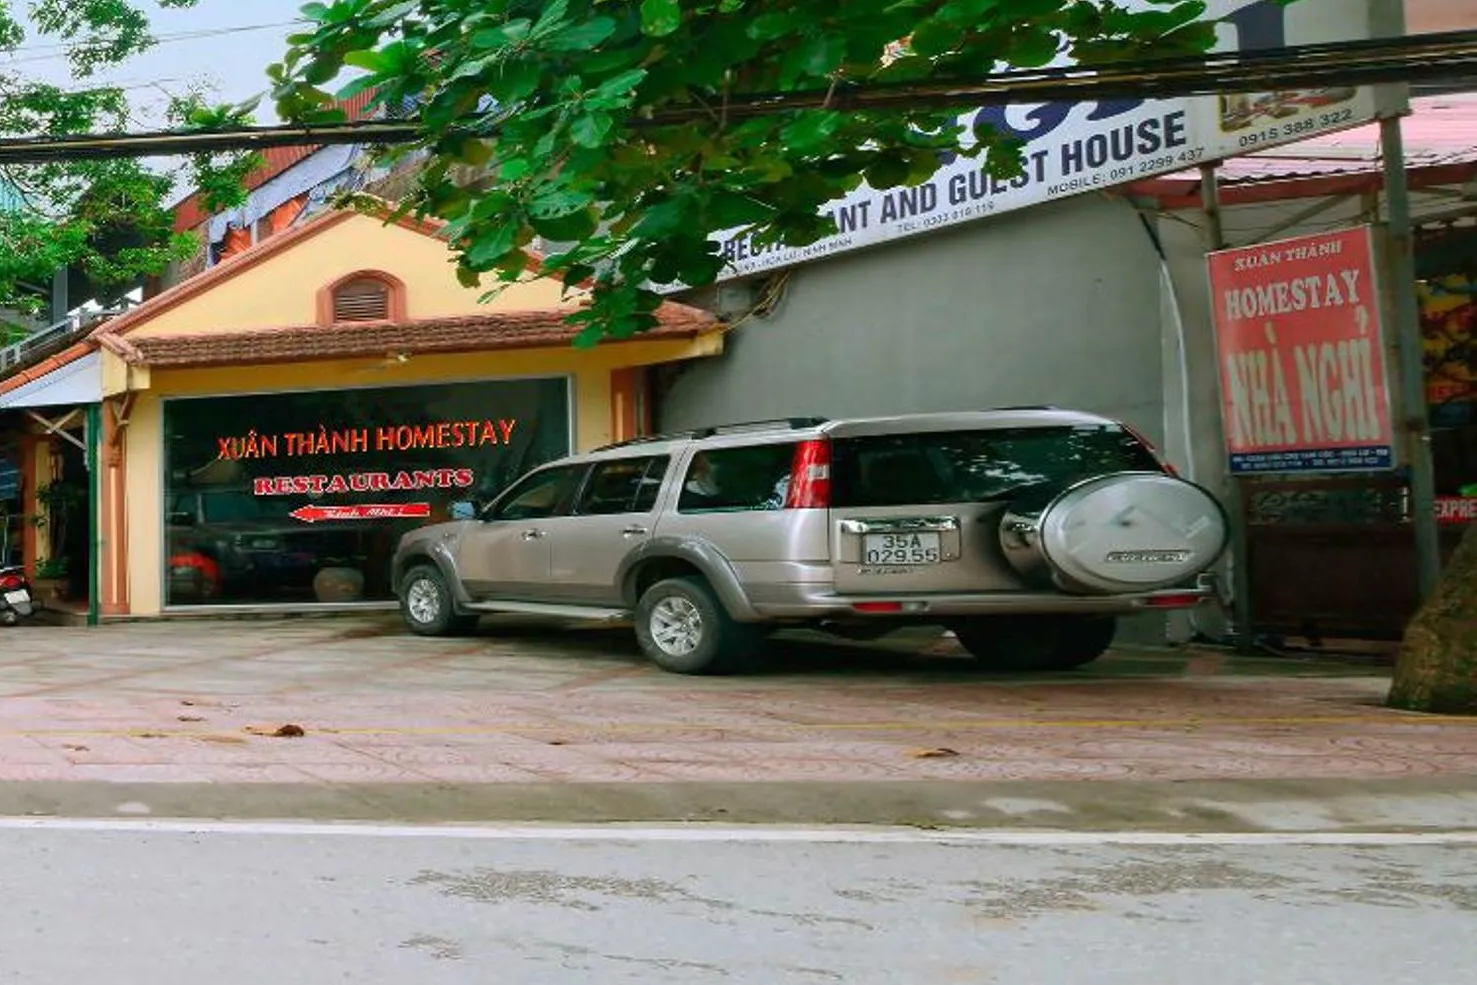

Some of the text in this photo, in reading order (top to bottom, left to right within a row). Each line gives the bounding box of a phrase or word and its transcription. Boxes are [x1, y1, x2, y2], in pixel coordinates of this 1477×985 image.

[1238, 109, 1352, 147] 0915 388 322
[880, 183, 937, 224] AND
[1061, 109, 1187, 176] HOUSE
[1048, 147, 1205, 196] MOBILE: 091 2299 437
[1224, 269, 1360, 321] HOMESTAY
[1228, 305, 1381, 447] NHÀ NGHỈ
[216, 417, 516, 460] XUÂN THÀNH HOMESTAY
[253, 468, 474, 496] RESTAURANTS
[883, 532, 921, 549] 35A
